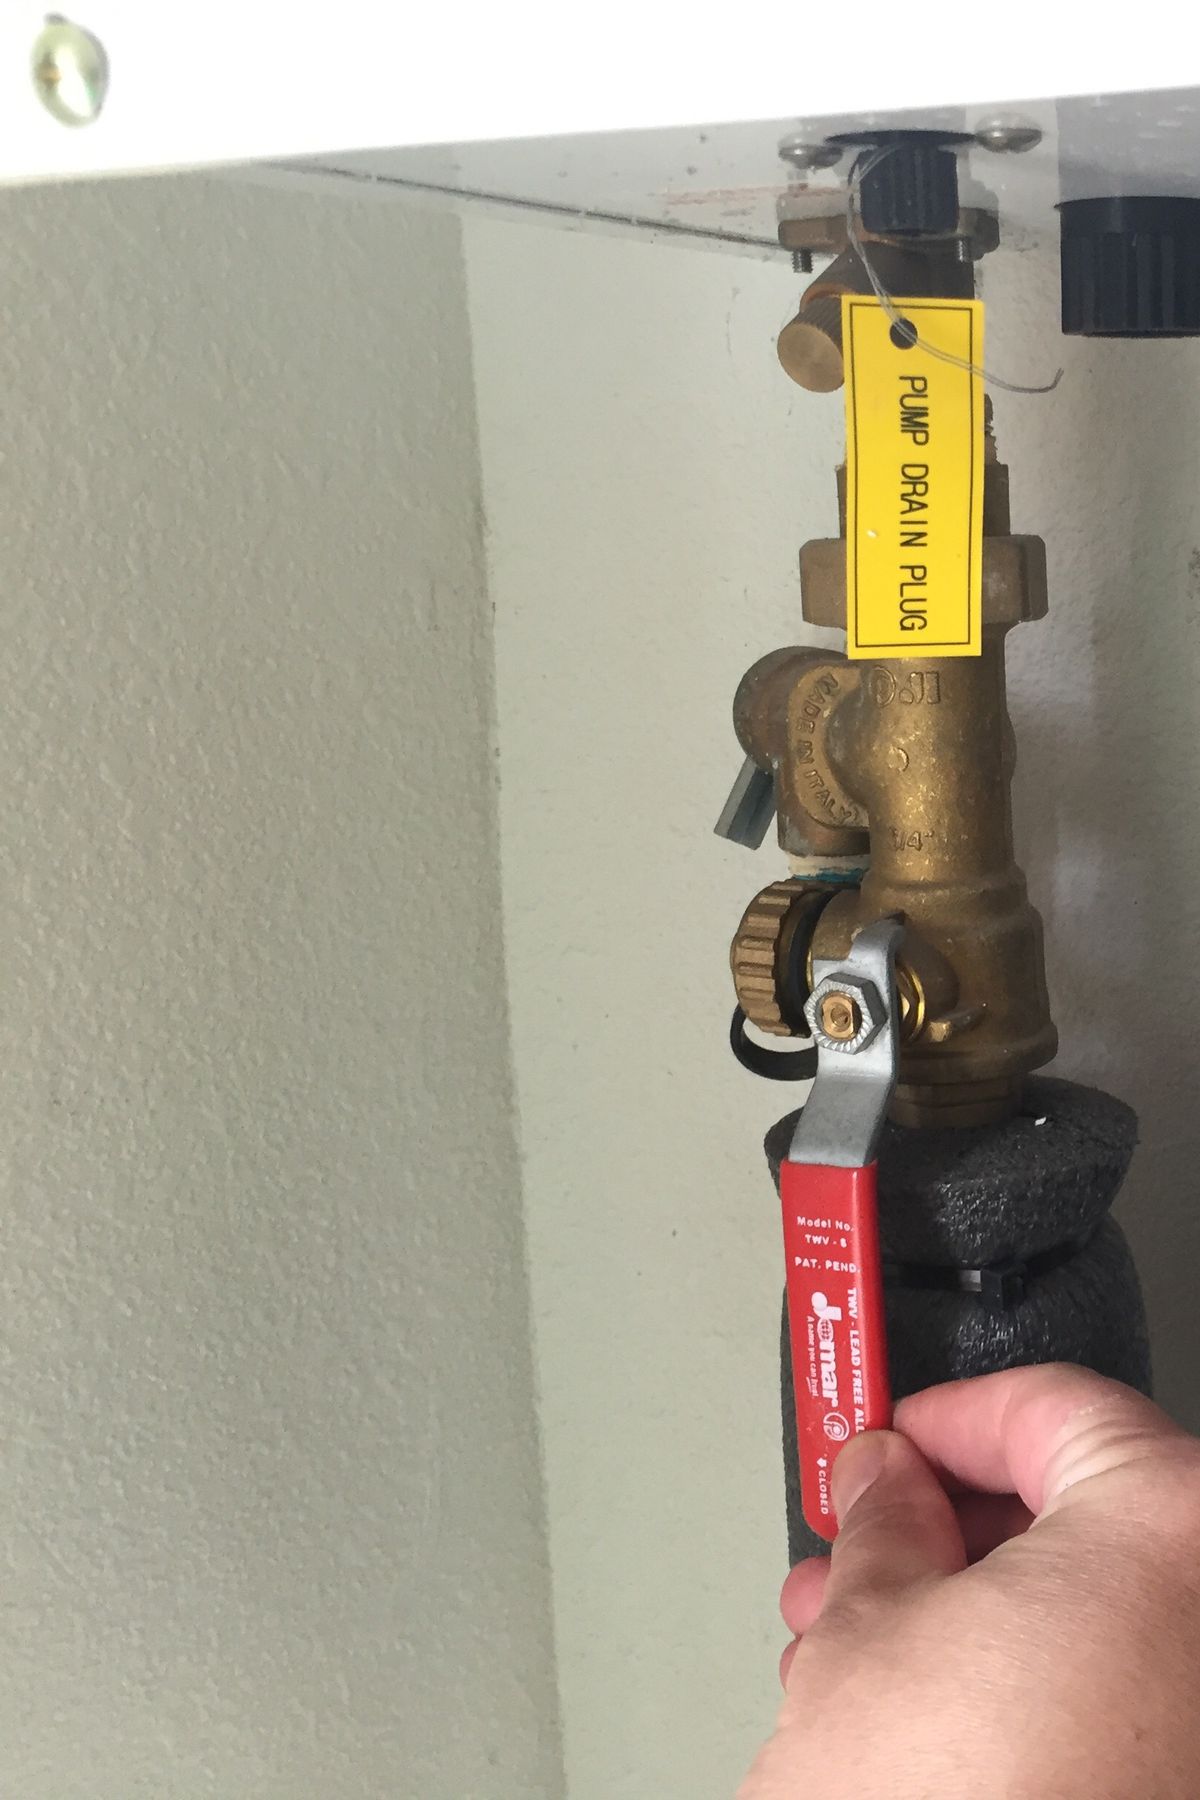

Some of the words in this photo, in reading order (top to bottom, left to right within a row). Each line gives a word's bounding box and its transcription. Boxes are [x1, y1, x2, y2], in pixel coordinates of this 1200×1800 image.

[898, 375, 930, 447] PUMP
[899, 463, 930, 549] DRAIN
[899, 564, 929, 632] PLUG
[795, 671, 839, 736] MADE
[796, 739, 814, 767] IN
[803, 769, 857, 822] ITALY
[796, 1216, 832, 1229] Model
[835, 1220, 855, 1232] No.
[805, 1233, 830, 1246] TWV
[794, 1256, 822, 1270] PAT.
[825, 1259, 862, 1274] PEND.
[847, 1287, 859, 1319] TWV
[811, 1291, 843, 1408] Jomar
[849, 1329, 862, 1366] LEAD
[851, 1369, 864, 1406] FREE
[853, 1408, 866, 1434] ALL
[818, 1469, 829, 1515] CLOSED
